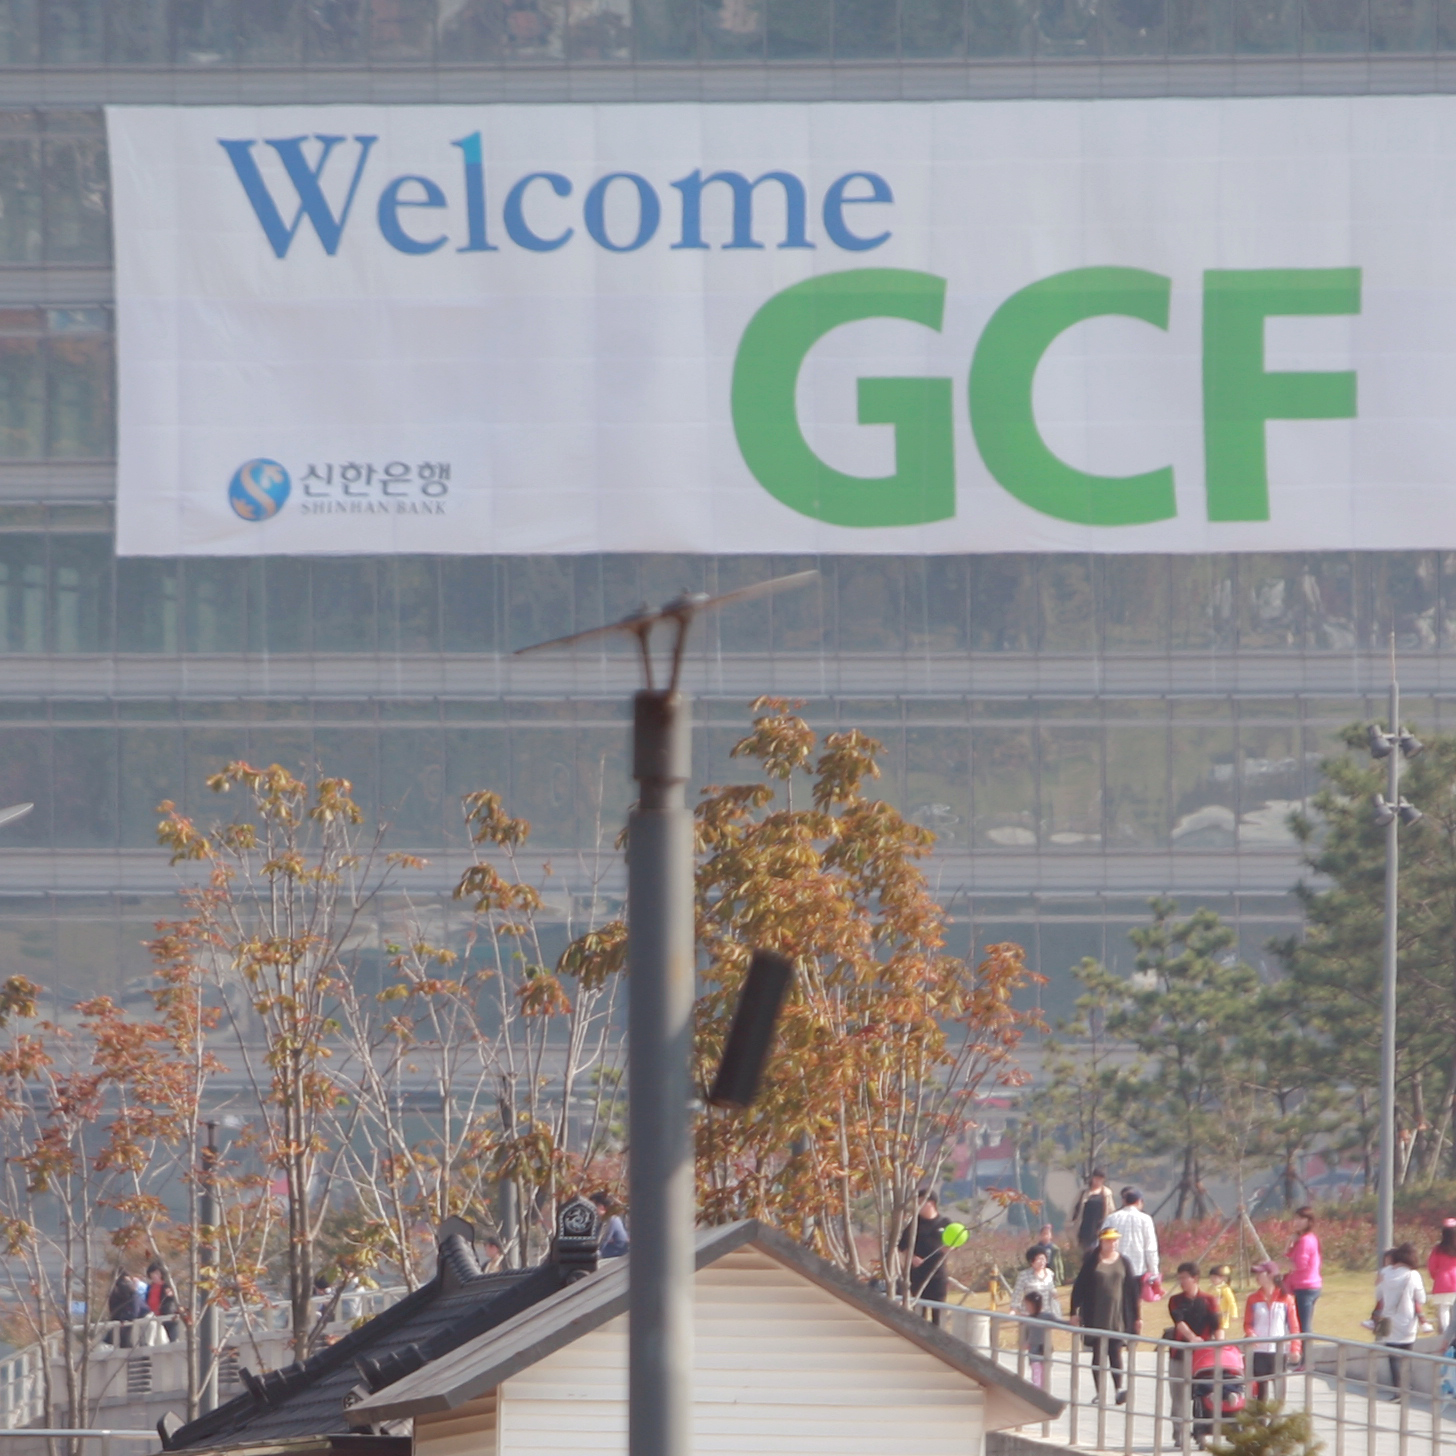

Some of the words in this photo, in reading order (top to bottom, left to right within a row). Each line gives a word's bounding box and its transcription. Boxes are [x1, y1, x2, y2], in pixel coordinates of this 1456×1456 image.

[217, 129, 894, 260] Welcome
[730, 265, 1363, 529] GCF
[300, 461, 452, 497] 신한은행
[300, 501, 391, 516] SHINHAN
[397, 501, 448, 516] BANK
